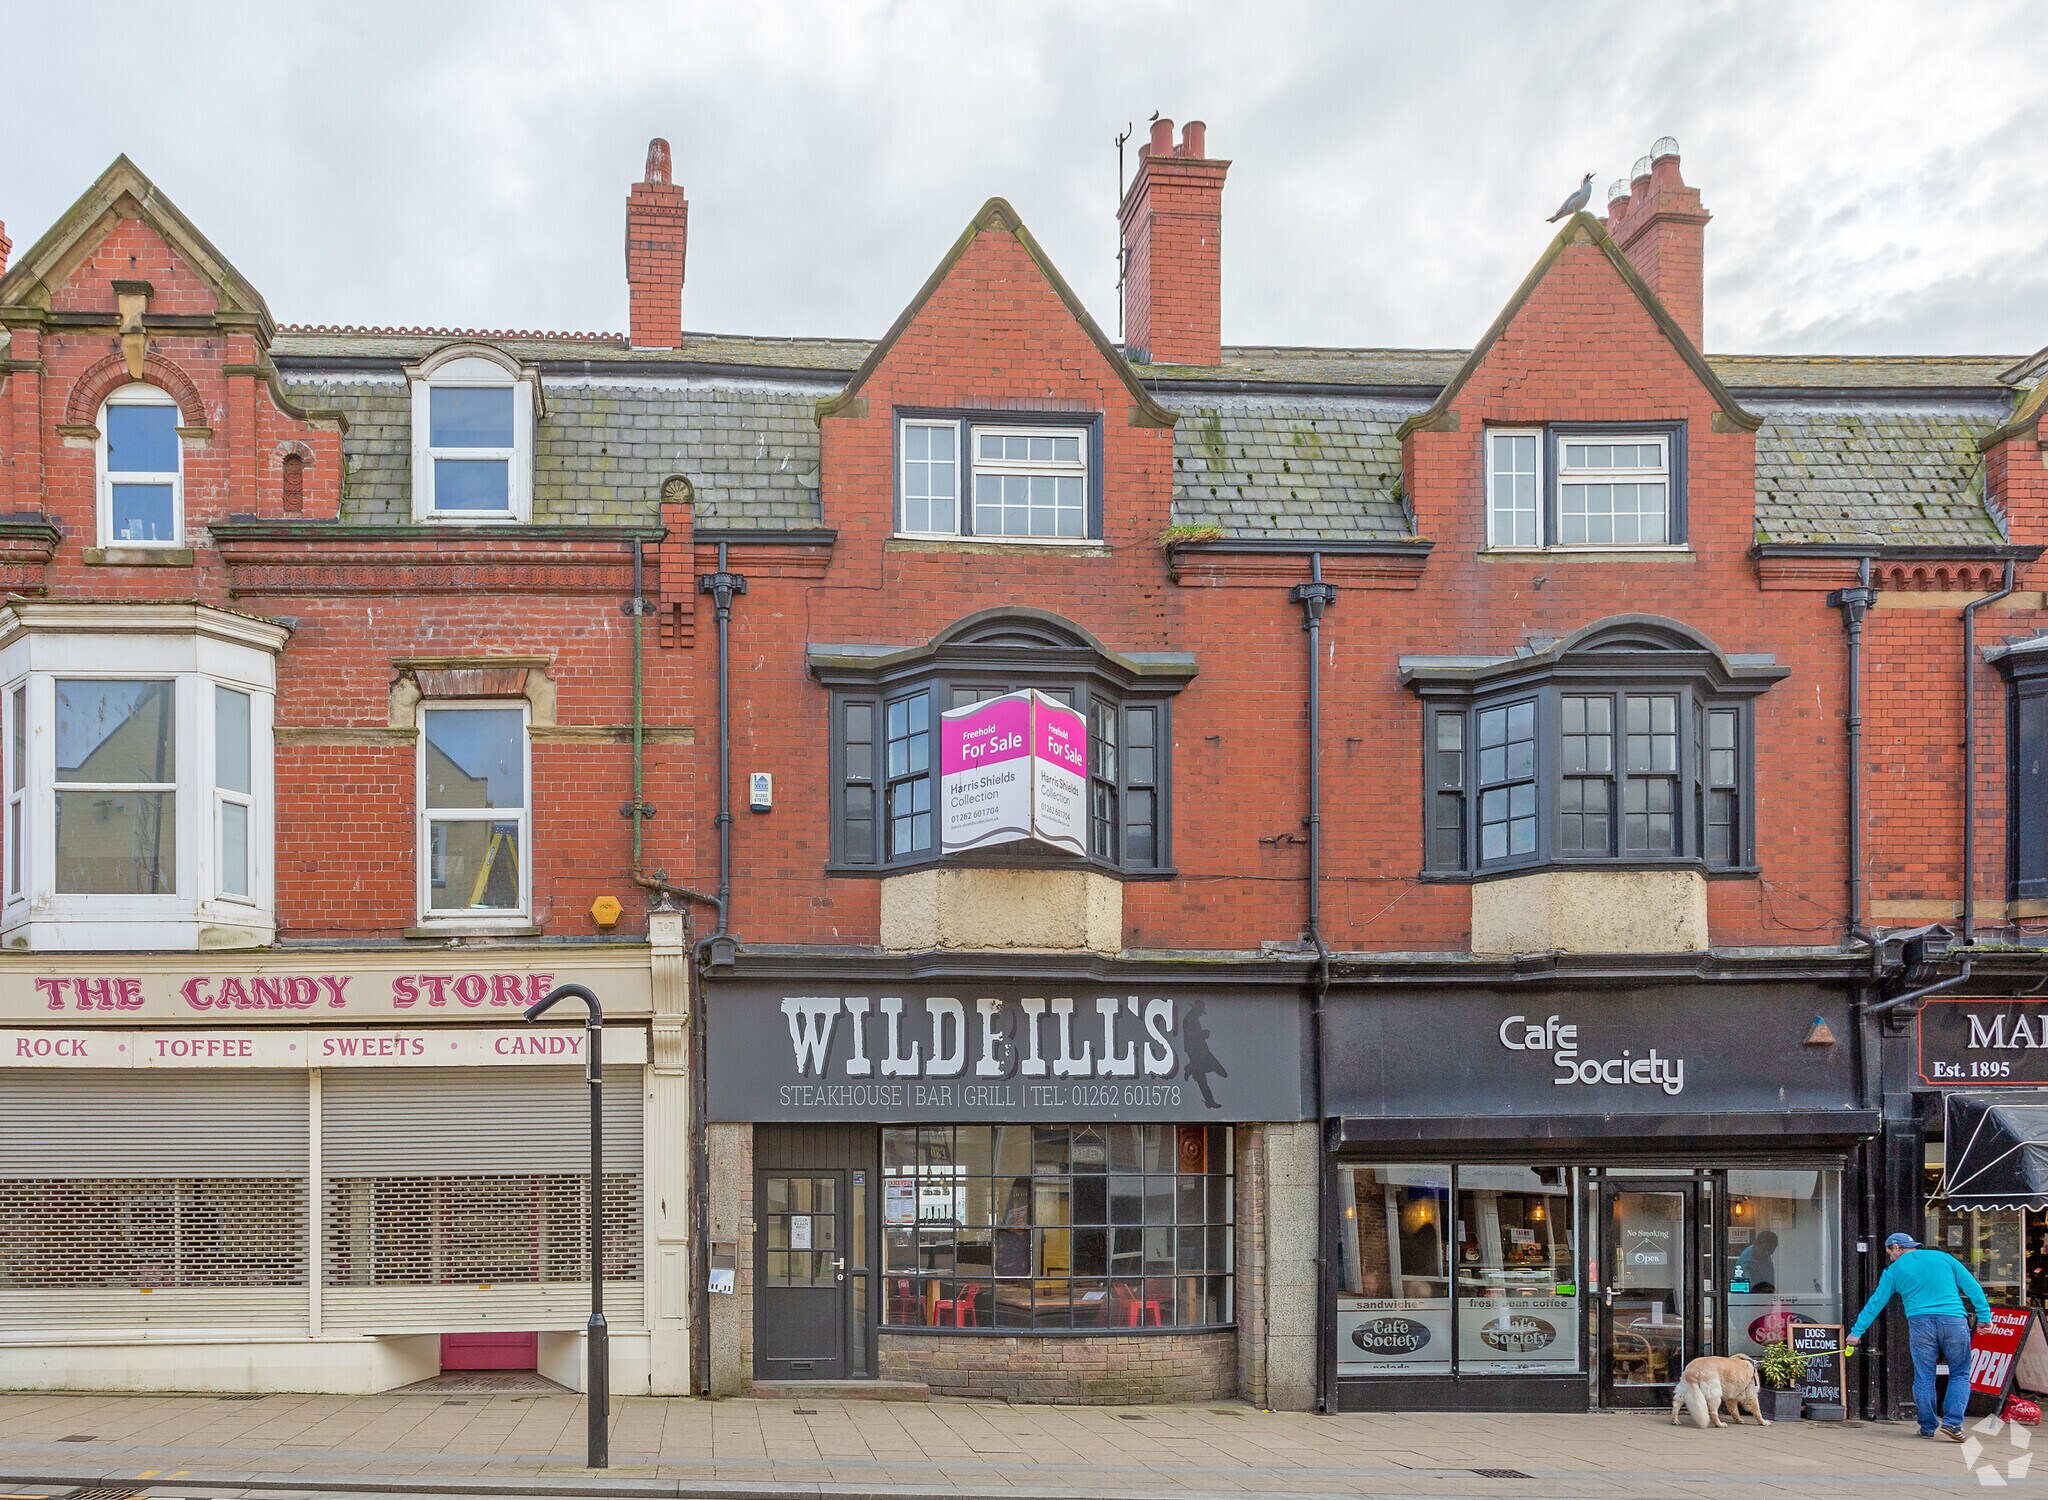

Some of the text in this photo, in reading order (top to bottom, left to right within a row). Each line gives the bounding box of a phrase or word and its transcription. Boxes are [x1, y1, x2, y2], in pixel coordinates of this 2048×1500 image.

[963, 723, 996, 741] Freehold
[1048, 723, 1069, 740] Freehold
[962, 732, 1022, 760] For Sale
[1048, 736, 1083, 767] For Sale
[950, 790, 999, 808] Collection
[1040, 784, 1071, 806] Collection
[951, 806, 999, 823] 01262 601704
[35, 972, 555, 1011] THE CANDY STORE
[15, 1036, 584, 1058] ROCK TOFFEE SWEETS CANDY
[1554, 1049, 1684, 1096] Society
[1933, 1061, 2010, 1078] Est. 1895
[780, 1085, 902, 1106] STEAKHOUSE
[915, 1085, 952, 1106] BAR
[964, 1085, 1015, 1106] GRILL
[1072, 1085, 1119, 1106] 01262
[1124, 1085, 1181, 1106] 601578
[1638, 1230, 1669, 1239] Smoking
[1634, 1252, 1660, 1264] Open
[1532, 1299, 1568, 1308] coffee
[1805, 1328, 1826, 1338] DOGS
[1990, 1323, 2015, 1337] hoes
[1363, 1332, 1420, 1351] Society
[1489, 1331, 1548, 1349] Society
[1794, 1339, 1838, 1350] WELCOME
[1970, 1348, 2013, 1388] OPEN
